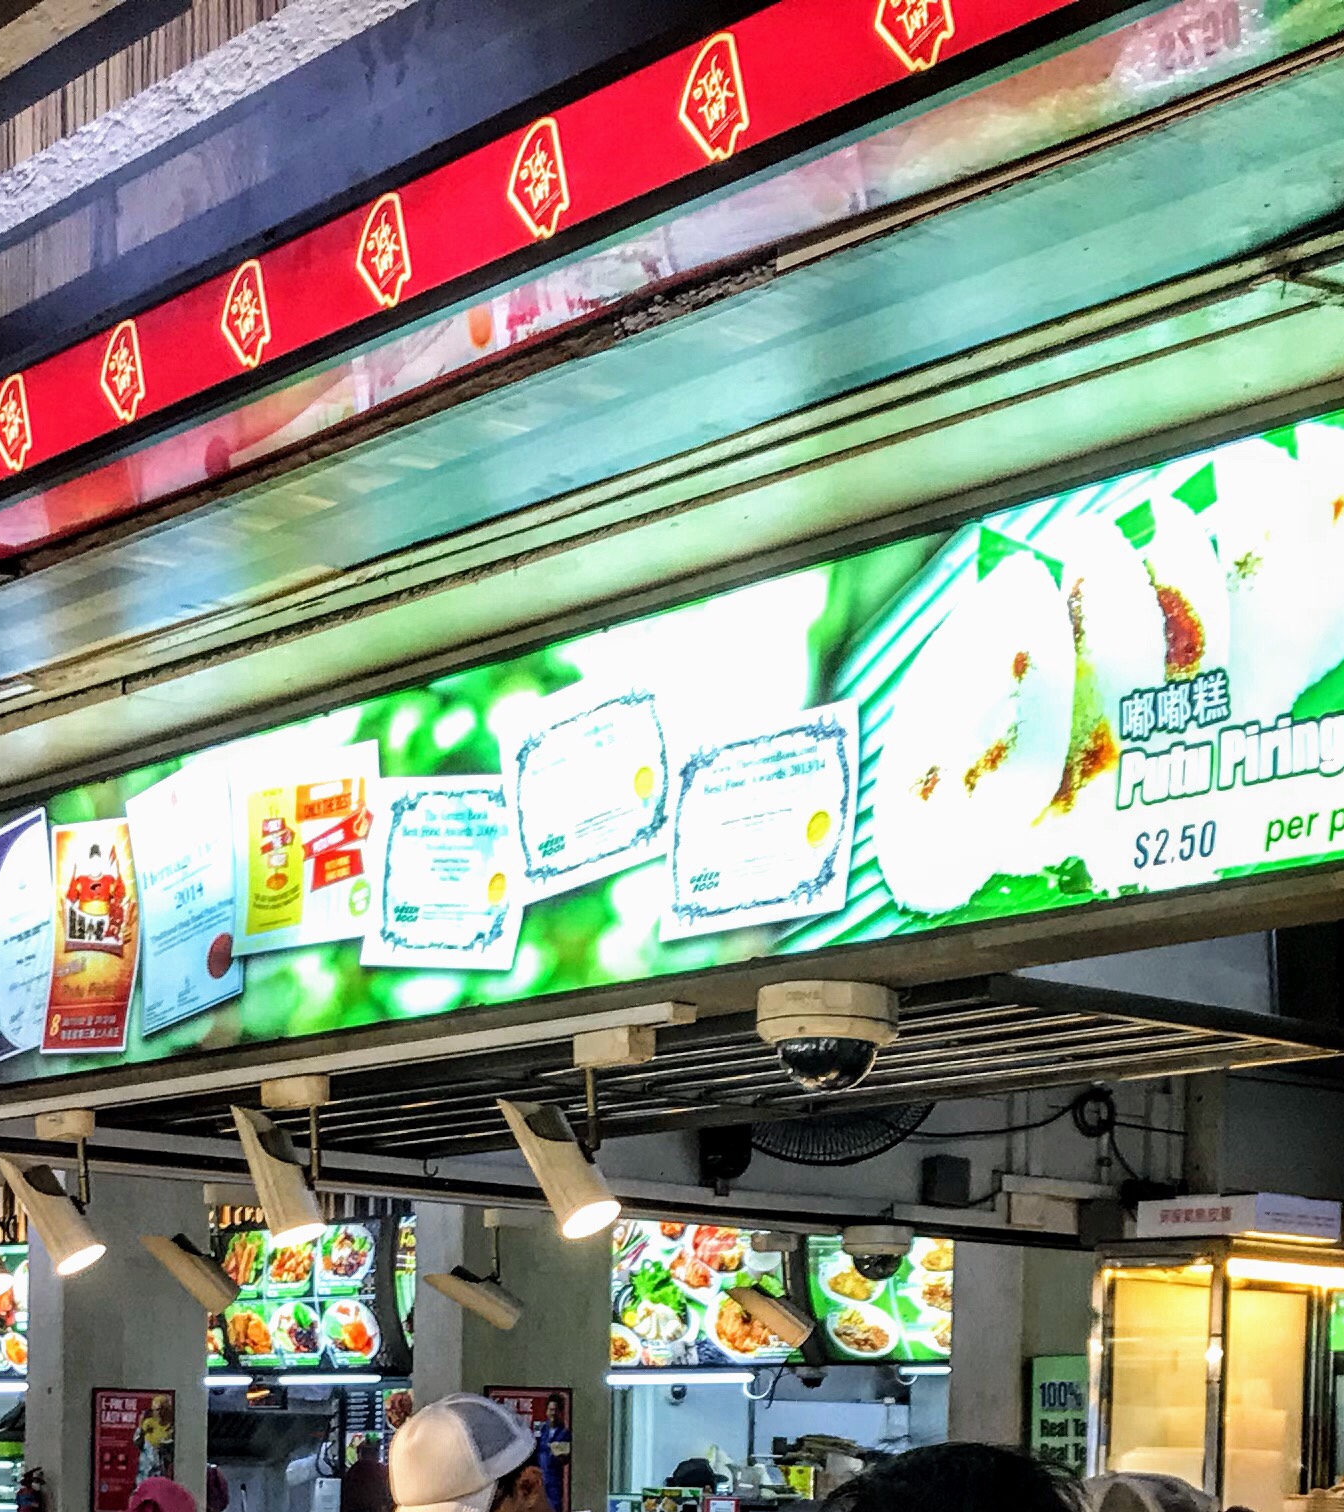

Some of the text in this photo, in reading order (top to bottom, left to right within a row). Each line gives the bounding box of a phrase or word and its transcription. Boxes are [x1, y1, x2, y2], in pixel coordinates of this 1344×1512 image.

[1121, 669, 1230, 740] 嘟嘟糕
[1117, 741, 1214, 810] Putu
[1134, 820, 1216, 869] $2.50
[1265, 812, 1320, 851] per
[1040, 1381, 1083, 1409] 100%
[1040, 1419, 1069, 1437] Real
